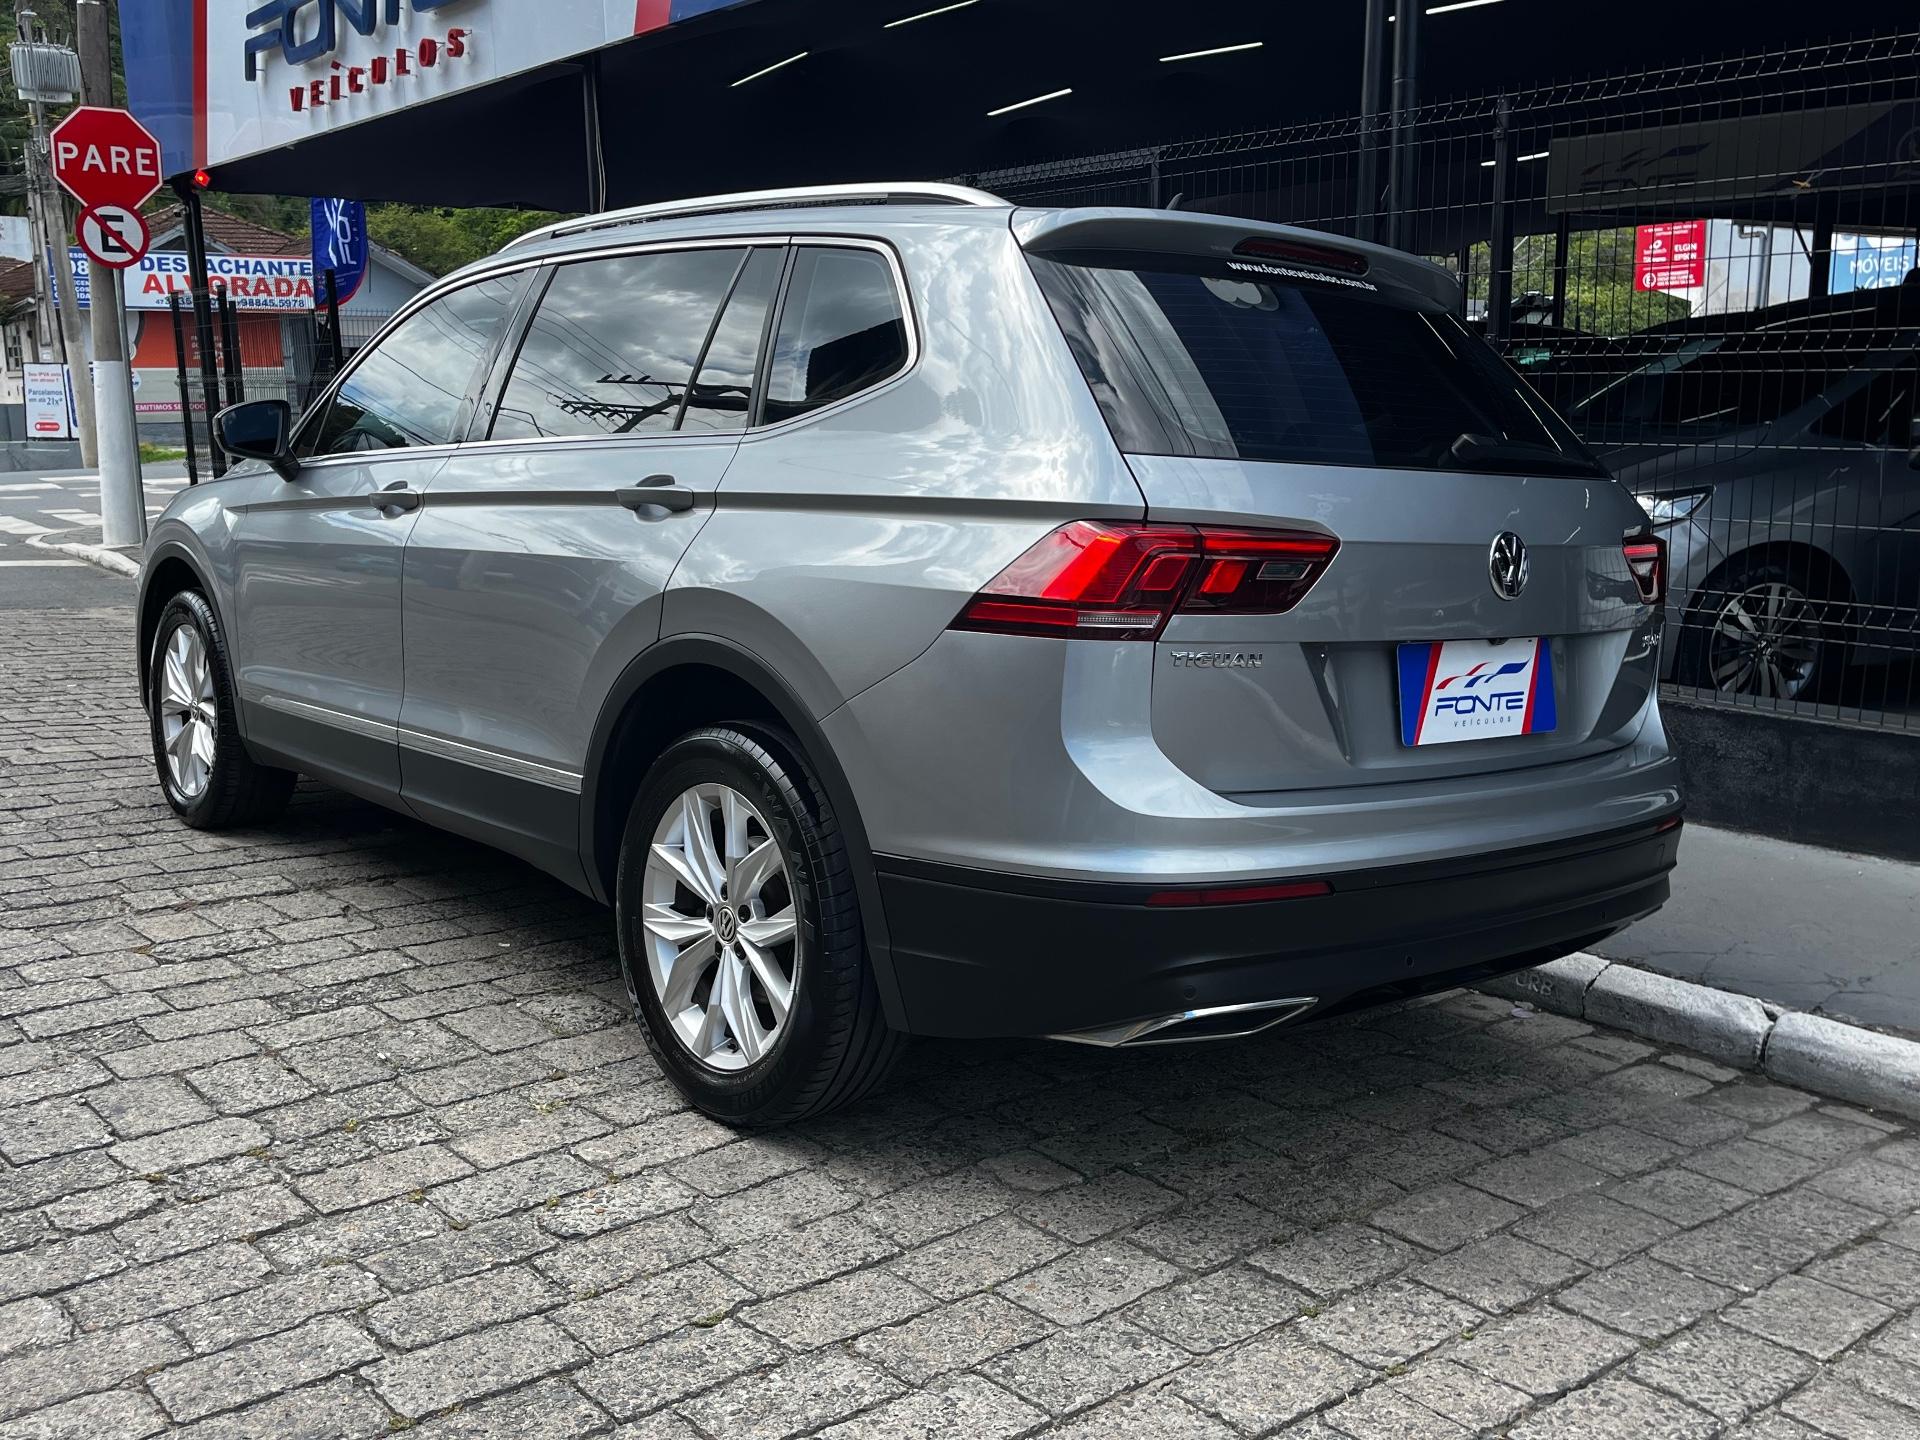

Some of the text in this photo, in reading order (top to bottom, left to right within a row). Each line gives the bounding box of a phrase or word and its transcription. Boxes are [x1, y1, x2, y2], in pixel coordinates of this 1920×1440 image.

[57, 141, 156, 176] PARE
[100, 213, 127, 253] E
[1674, 243, 1698, 252] ELGIN
[140, 256, 313, 276] DESACHANTE
[1849, 254, 1910, 274] MÓVEIS
[1226, 261, 1378, 291] www.fonteveiculos.com.br
[135, 403, 169, 411] EMITIMOS
[1170, 650, 1263, 669] TIGUAN
[1434, 691, 1525, 717] FONTE
[1453, 715, 1512, 728] VEÍCULOS
